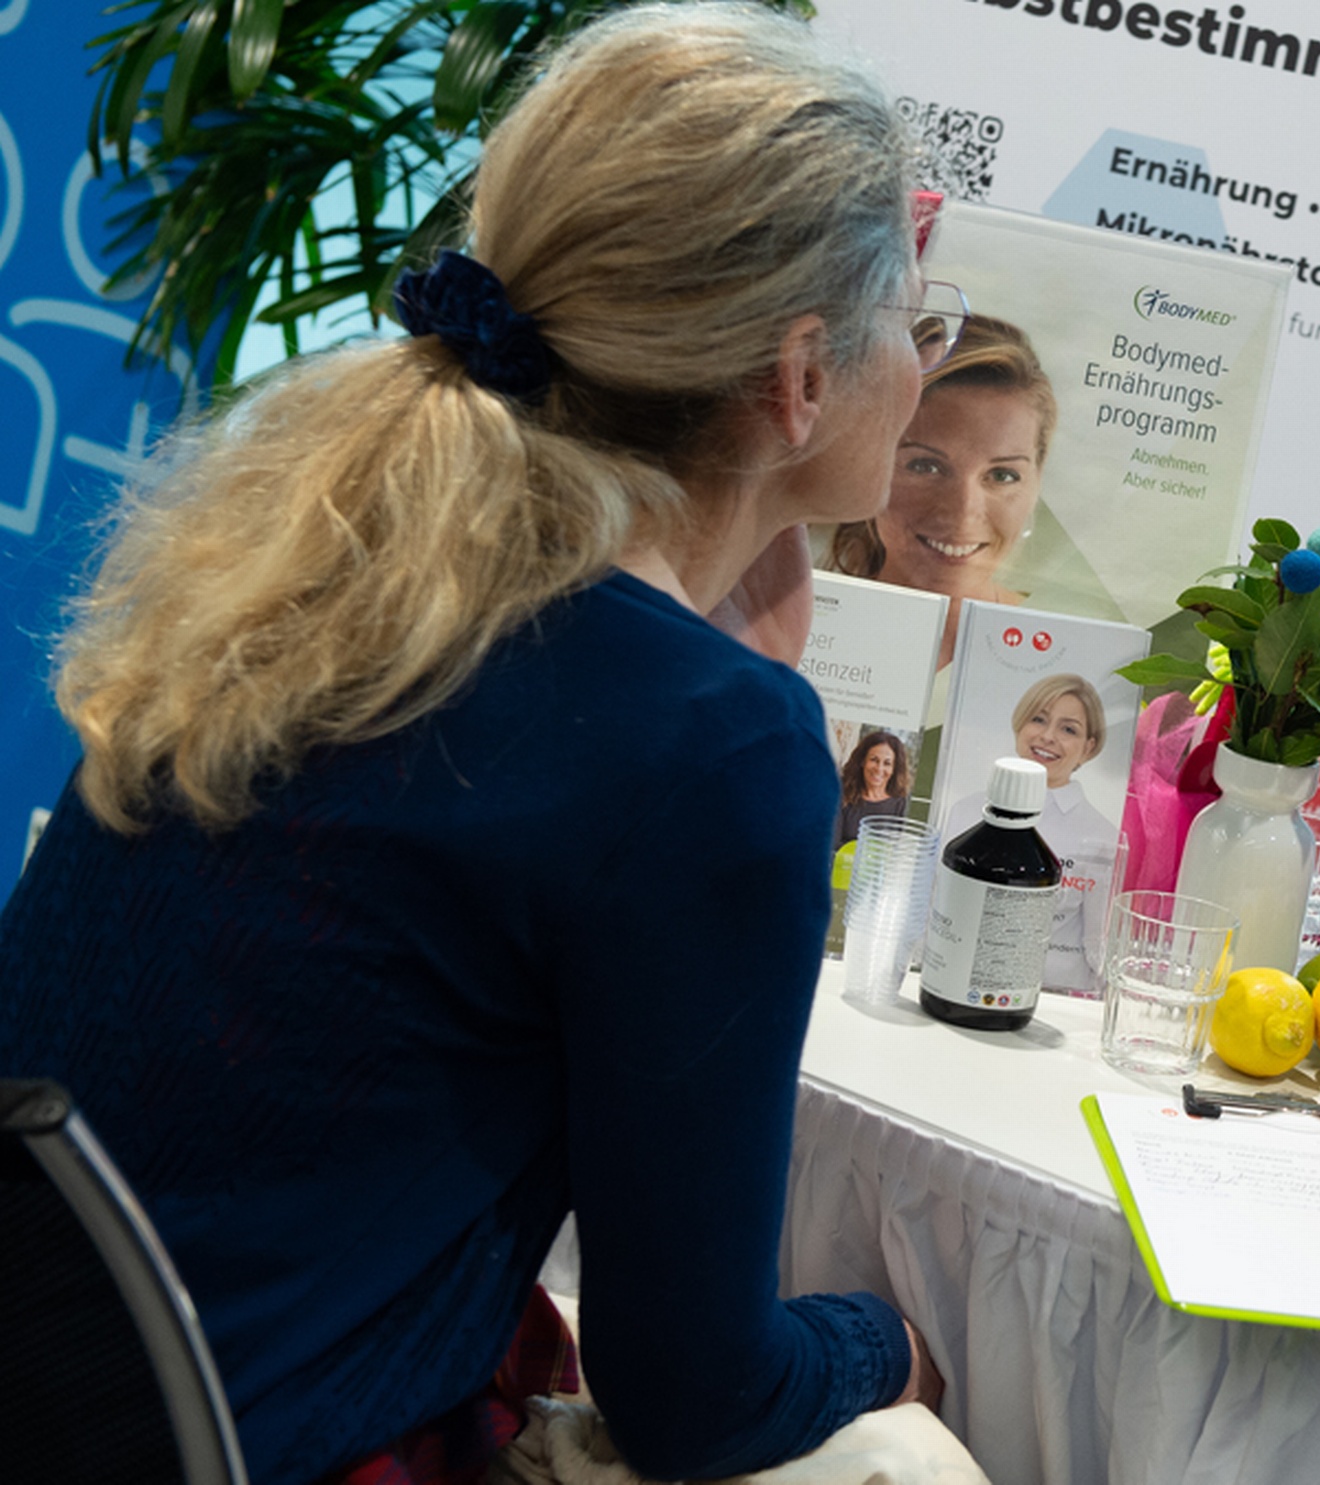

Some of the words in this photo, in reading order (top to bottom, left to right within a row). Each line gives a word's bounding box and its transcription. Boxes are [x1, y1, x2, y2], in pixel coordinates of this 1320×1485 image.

[1109, 147, 1298, 220] Ernährung
[1111, 334, 1230, 377] Bodymed-
[1084, 362, 1223, 413] Ernährungs-
[1096, 403, 1217, 443] programm
[1122, 471, 1157, 491] Aber
